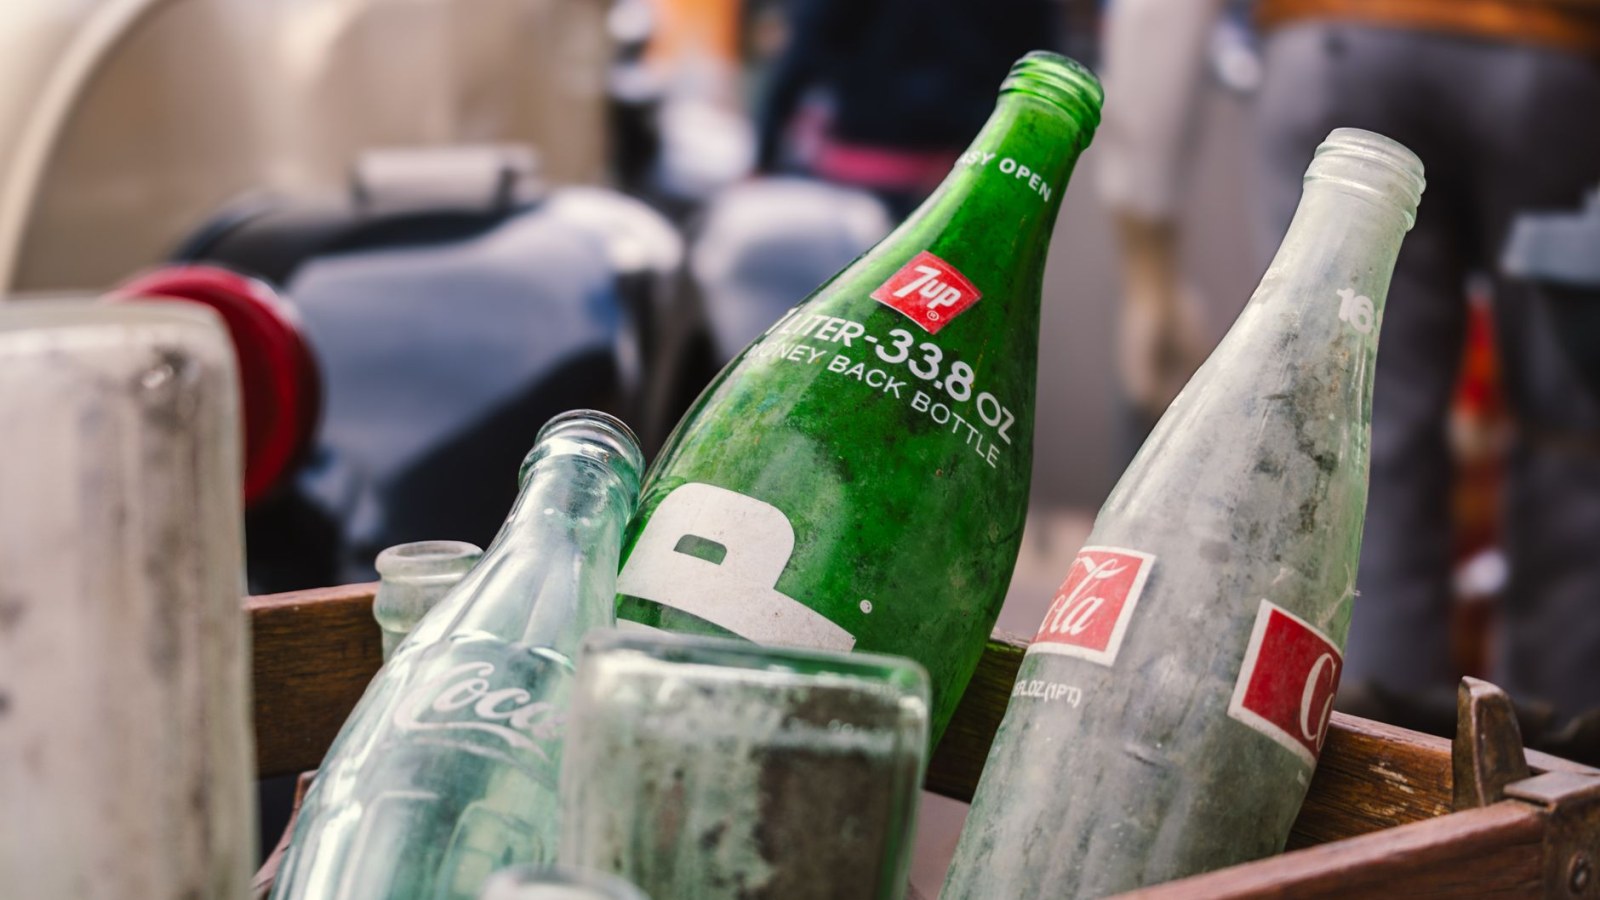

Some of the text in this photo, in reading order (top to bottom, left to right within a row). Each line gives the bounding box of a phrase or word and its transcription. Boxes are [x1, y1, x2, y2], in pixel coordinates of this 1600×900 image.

[998, 157, 1052, 203] OPEN
[1335, 287, 1375, 335] 16
[827, 353, 907, 400] BACK
[910, 389, 1001, 469] BOTTLE
[975, 390, 1016, 446] OZ
